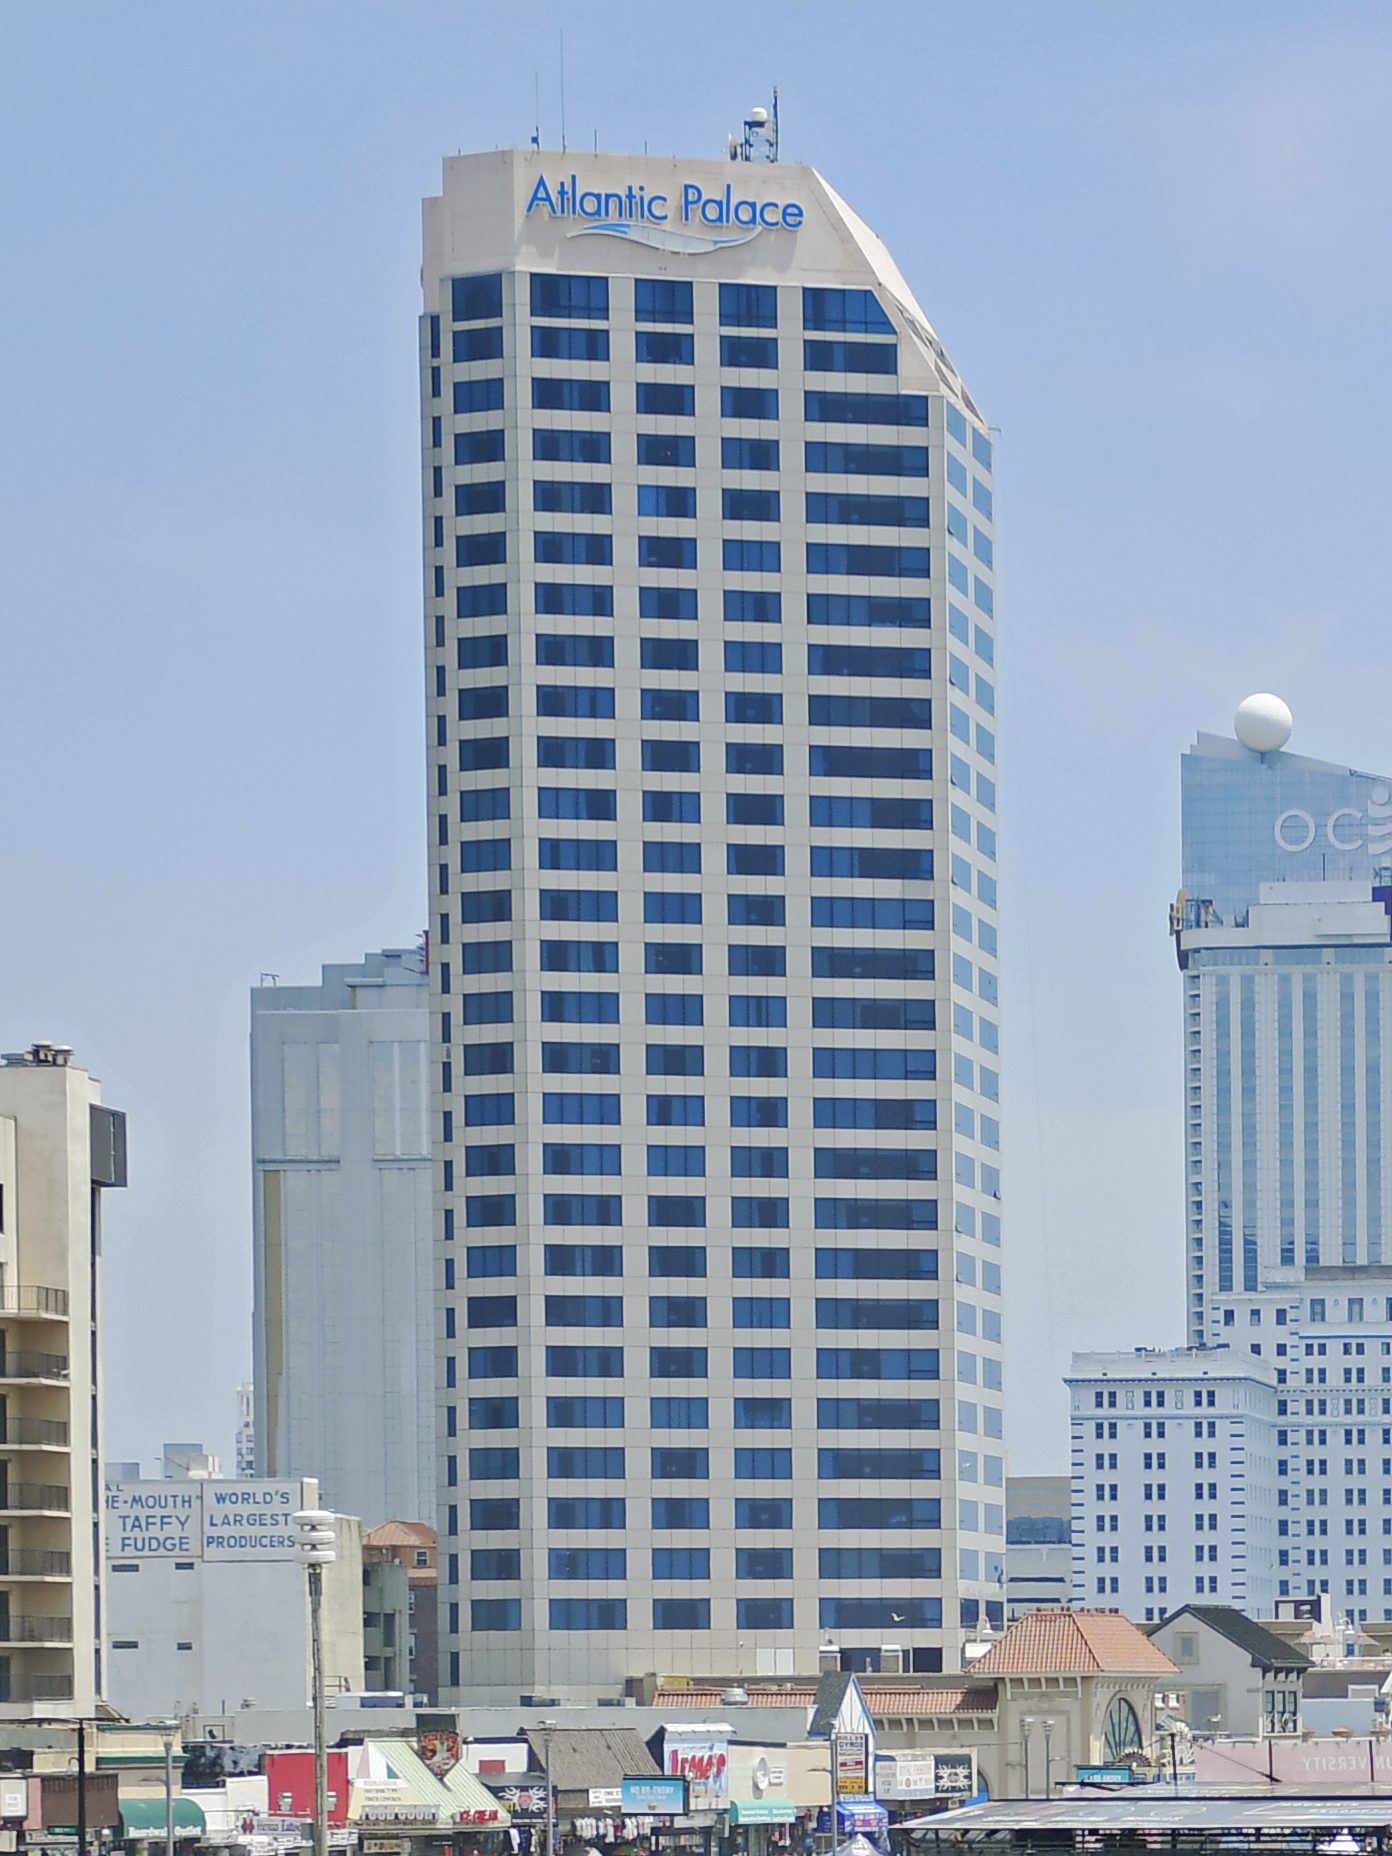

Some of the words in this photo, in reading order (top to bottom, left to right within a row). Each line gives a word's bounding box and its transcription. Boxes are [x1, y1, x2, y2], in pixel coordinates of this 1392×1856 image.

[526, 173, 668, 222] Atlantic
[681, 183, 805, 229] Palace
[214, 1490, 291, 1504] WORLD'S
[118, 1515, 191, 1532] TAFFY
[209, 1512, 292, 1528] LARGEST
[121, 1536, 190, 1552] FUDGE
[206, 1535, 296, 1548] PRODUCERS
